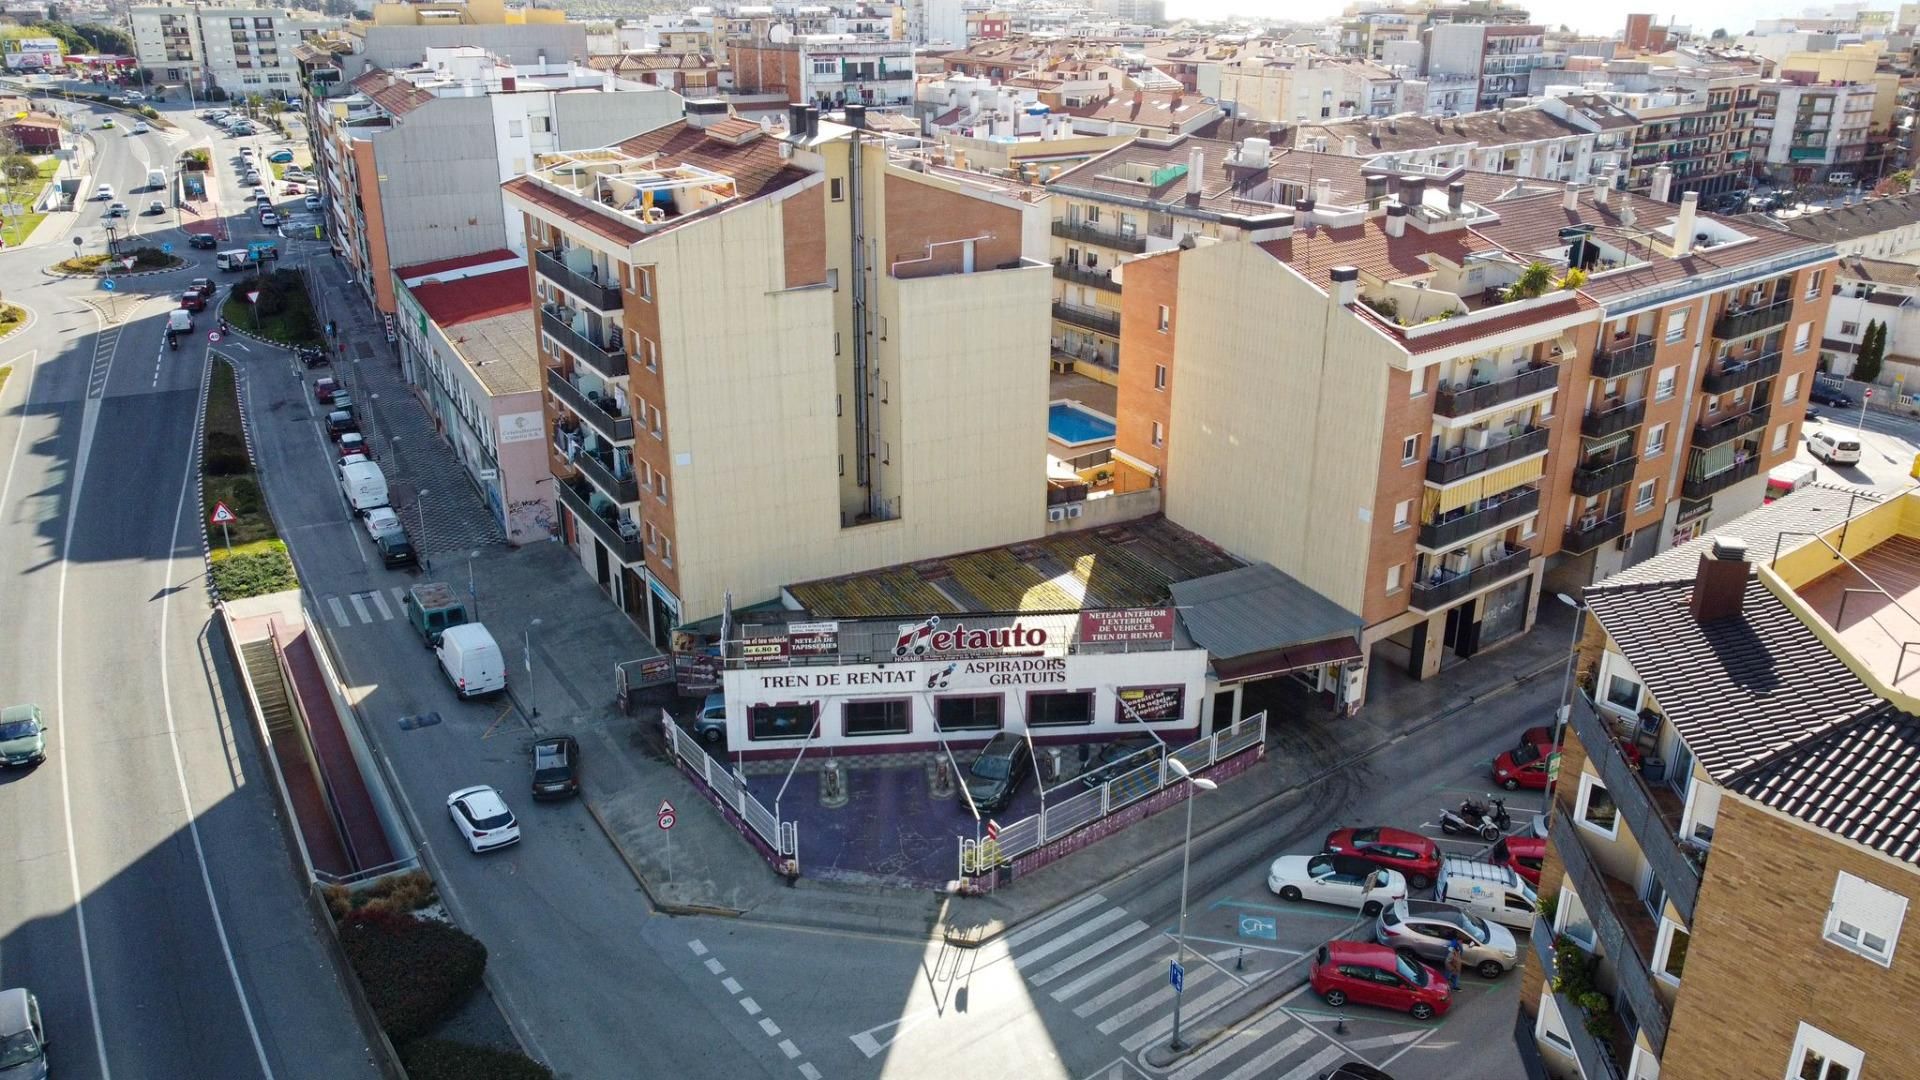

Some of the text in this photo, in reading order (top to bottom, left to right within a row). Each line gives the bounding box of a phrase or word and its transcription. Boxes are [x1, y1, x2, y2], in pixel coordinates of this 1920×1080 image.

[1089, 609, 1166, 619] NETEJA INTERIOR
[1108, 617, 1152, 625] EXTERIOR
[1113, 623, 1155, 632] VEHICLES
[1117, 632, 1129, 640] DE
[1130, 631, 1163, 639] RENTAT
[965, 658, 1066, 674] ASPIRADORS
[760, 670, 916, 689] TREN DE RENTAT
[990, 671, 1066, 685] GRATUITS
